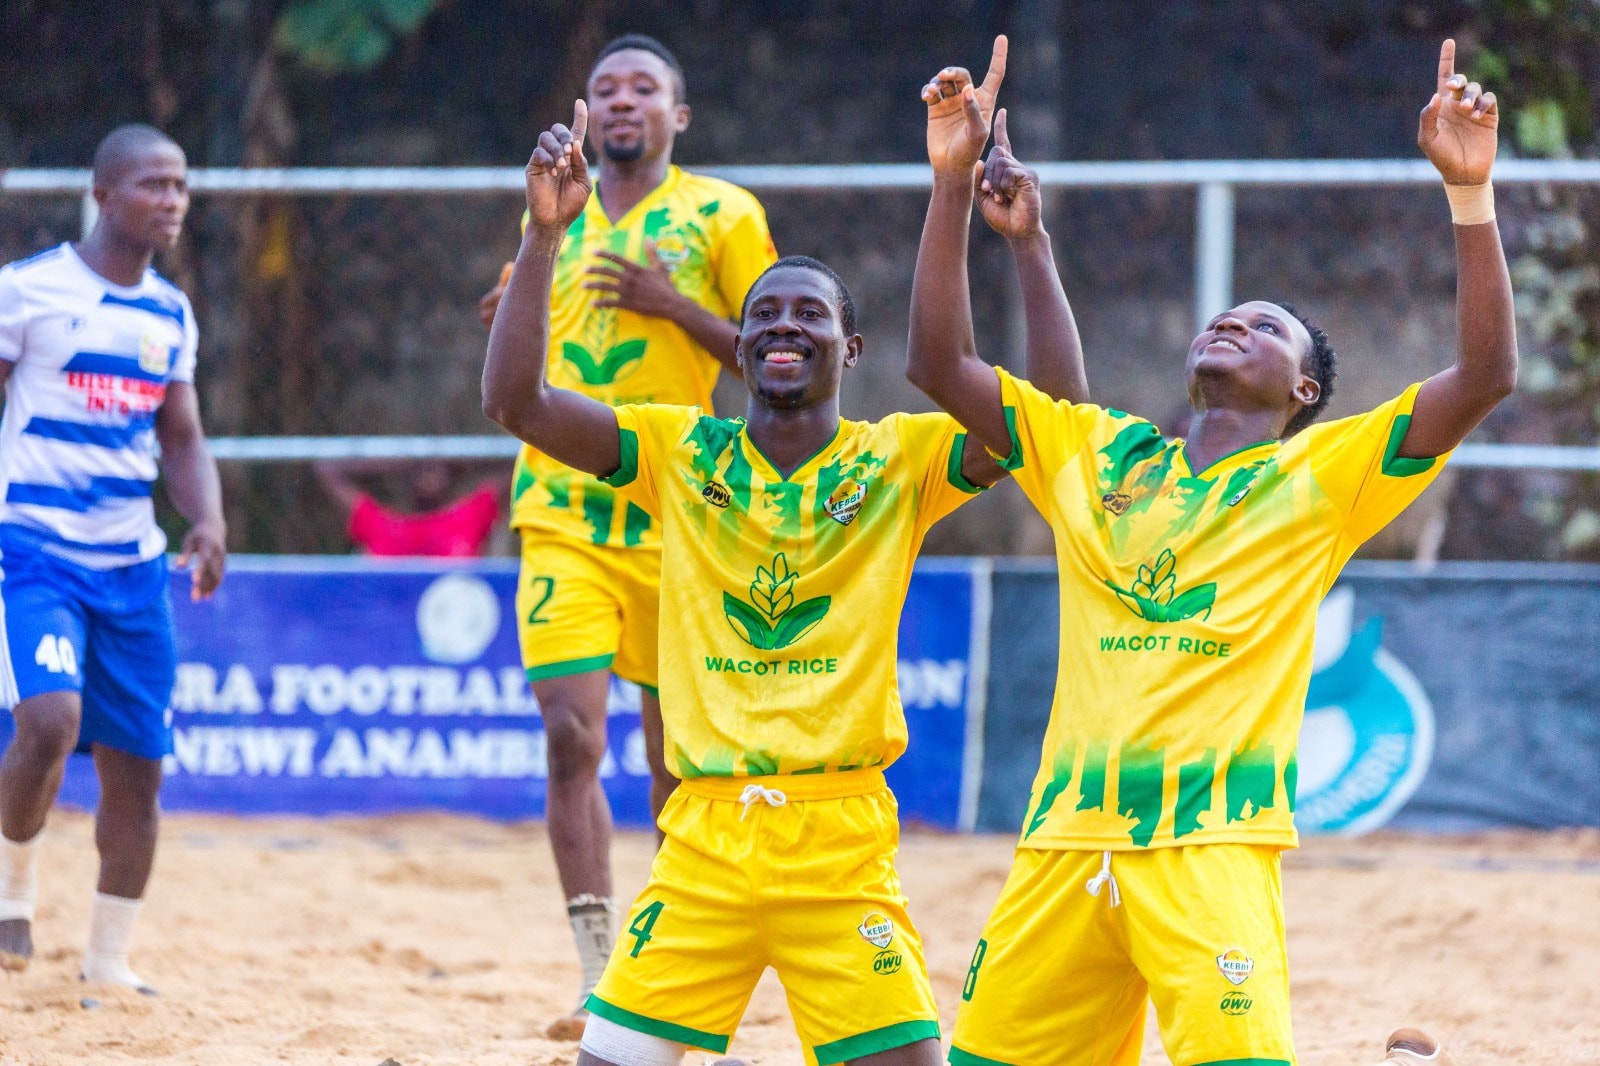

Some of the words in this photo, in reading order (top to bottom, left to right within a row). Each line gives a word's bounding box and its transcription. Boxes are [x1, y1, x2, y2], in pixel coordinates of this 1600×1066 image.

[831, 492, 860, 511] KEBBI
[528, 577, 556, 625] 2
[35, 633, 76, 676] 40
[1100, 635, 1171, 652] WACOT
[1178, 637, 1231, 657] RICE
[705, 656, 781, 676] WACOT
[788, 658, 838, 675] RICE
[172, 662, 262, 714] RA
[269, 663, 541, 716] FOOTBAL
[162, 726, 316, 777] NEWI
[628, 900, 665, 959] 4
[866, 924, 890, 936] KEBBI
[873, 954, 902, 972] OWU
[1223, 961, 1249, 971] KEBBI
[1220, 998, 1253, 1010] OWU
